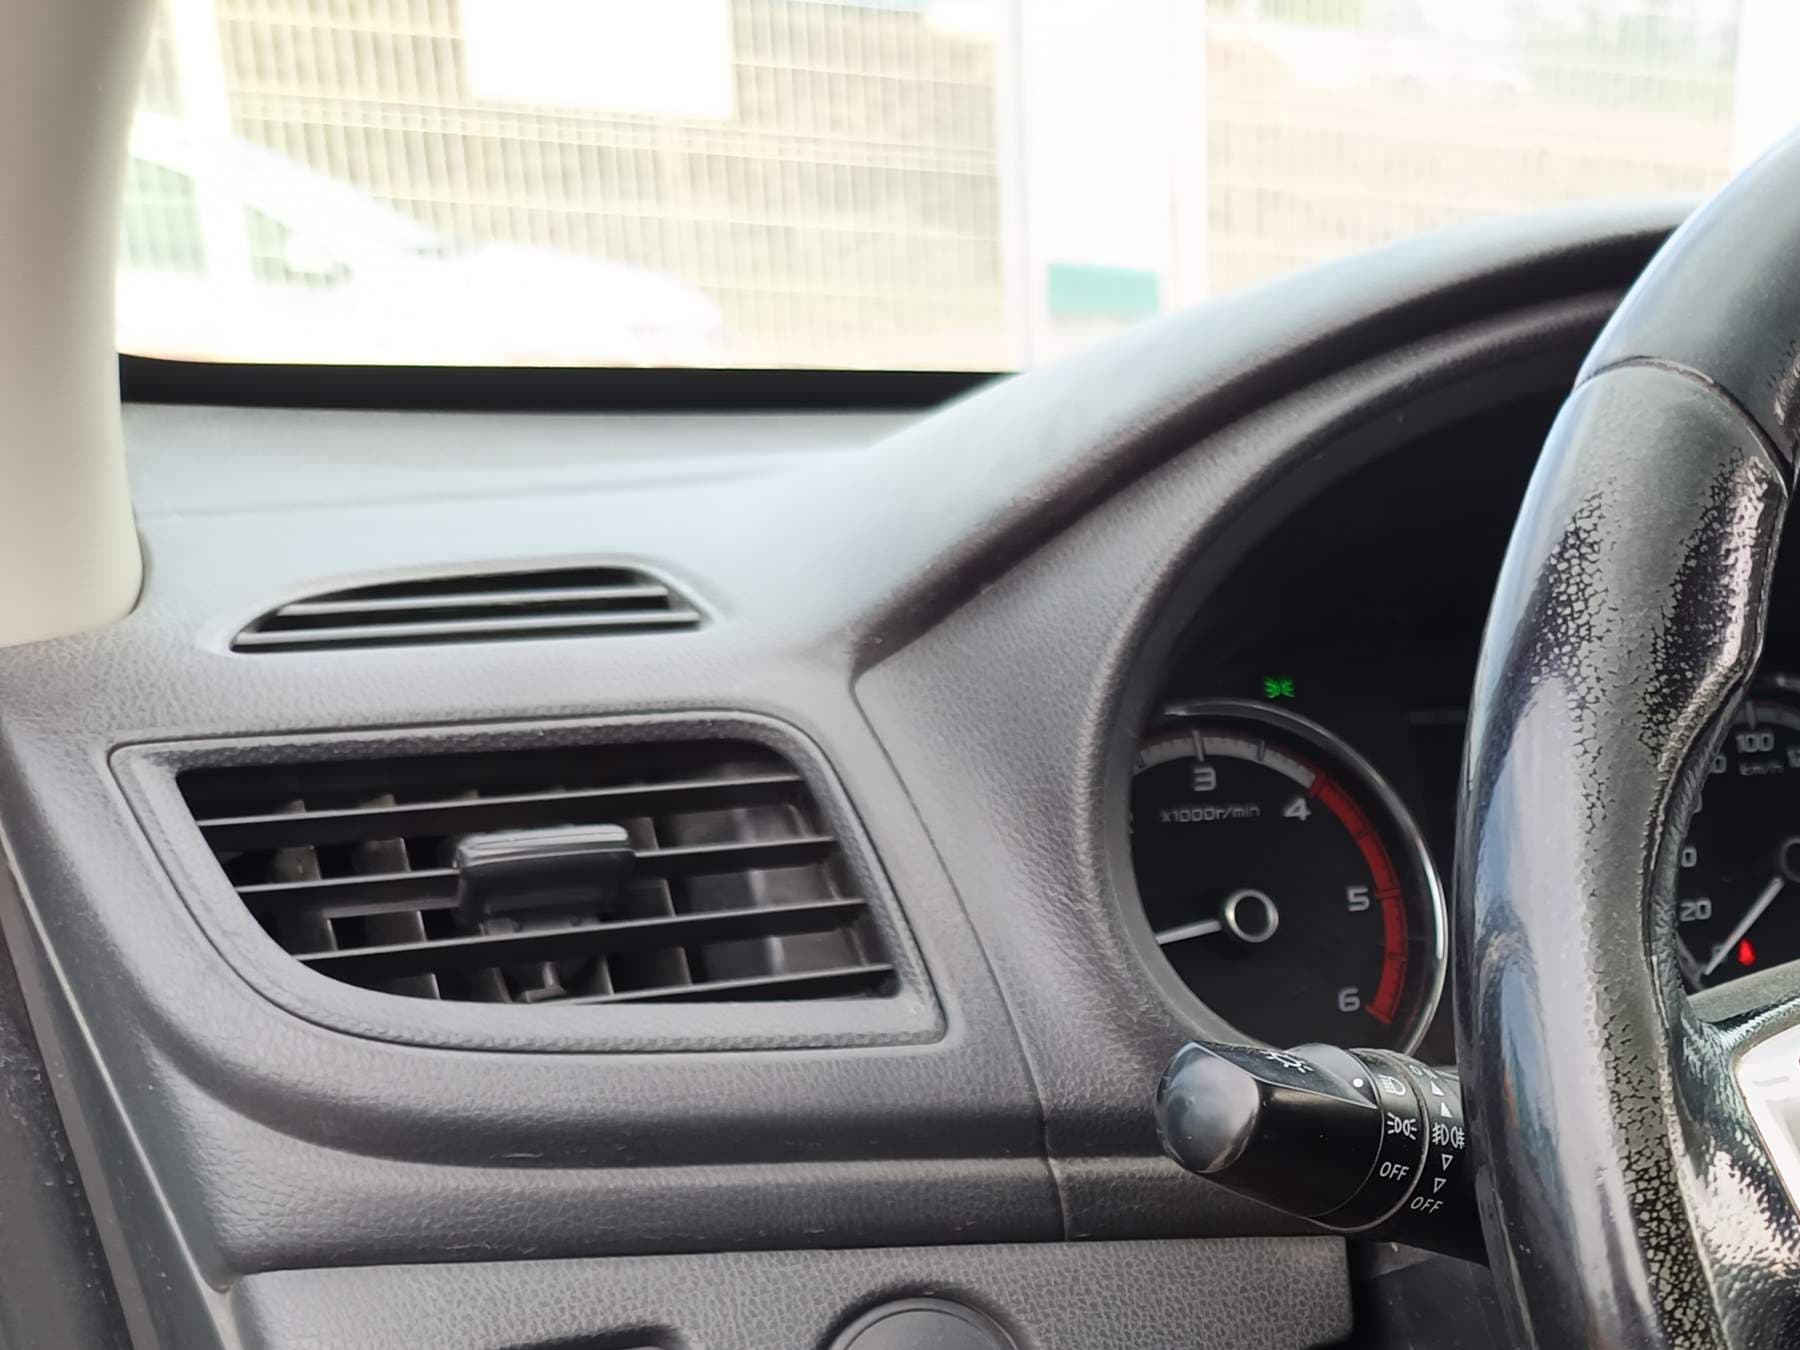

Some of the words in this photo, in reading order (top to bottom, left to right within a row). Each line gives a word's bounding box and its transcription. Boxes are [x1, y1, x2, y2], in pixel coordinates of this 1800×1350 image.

[1736, 732, 1775, 753] 100
[1193, 766, 1217, 791] 3
[1283, 798, 1311, 821] 4
[1347, 886, 1370, 912] 5
[1679, 897, 1712, 921] 20
[1338, 987, 1360, 1012] 6
[1379, 1161, 1409, 1182] OFF
[1410, 1196, 1444, 1214] OFF
